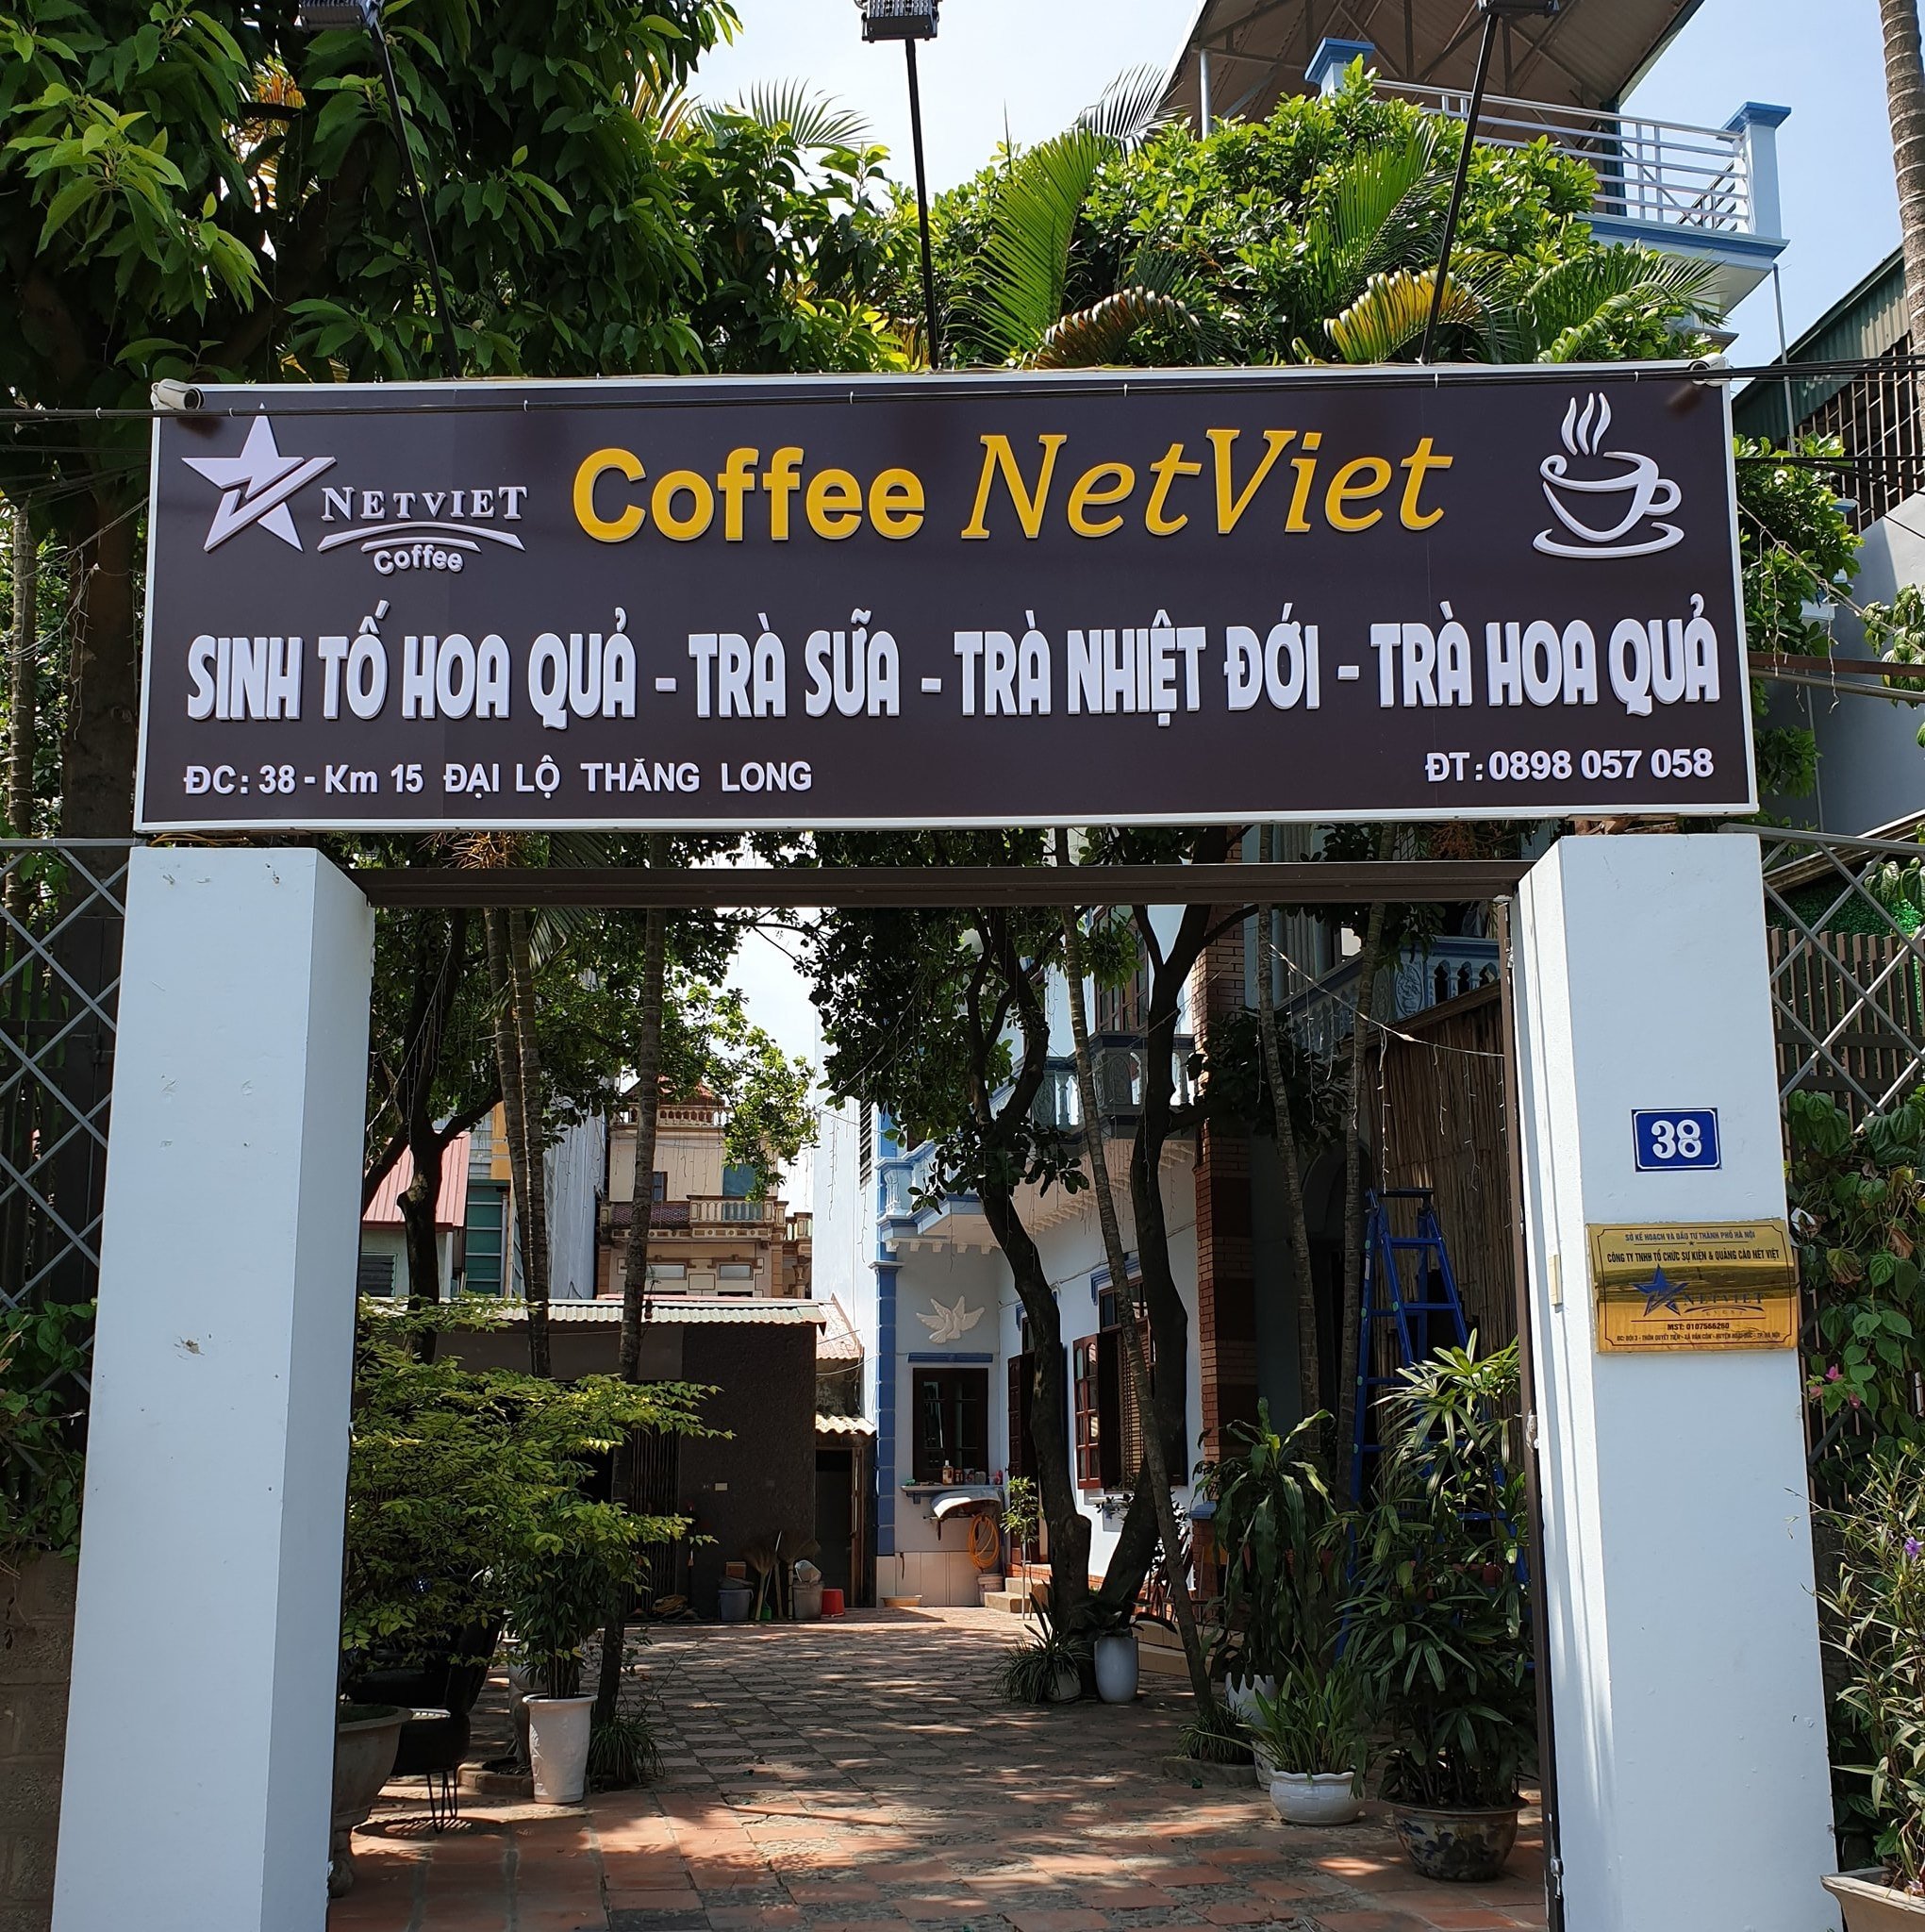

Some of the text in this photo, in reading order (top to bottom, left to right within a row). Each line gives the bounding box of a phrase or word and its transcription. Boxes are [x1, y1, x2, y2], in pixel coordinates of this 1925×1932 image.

[320, 485, 528, 523] NETVIET
[573, 428, 1453, 542] Coffee NetViet
[373, 544, 464, 575] Coffee
[188, 635, 303, 721] SINH
[318, 599, 390, 721] TỐ
[402, 633, 511, 720] HOA
[528, 606, 639, 730] QUẢ
[689, 612, 787, 719] TRÀ
[805, 608, 901, 719] SỮA
[954, 609, 1053, 717] TRÀ
[1067, 608, 1207, 727] NHIỆT
[1225, 603, 1320, 712] ĐỚI
[1370, 601, 1473, 709] TRÀ
[1486, 620, 1599, 708] HOA
[1609, 593, 1721, 717] QUẢ
[184, 765, 250, 796] ĐC:
[258, 765, 296, 794] 38
[325, 765, 378, 794] Km
[390, 763, 424, 794] 15
[442, 763, 501, 799] ĐẠI
[515, 755, 561, 801] LỘ
[581, 758, 701, 792] THĂNG
[721, 761, 812, 792] LONG
[1581, 749, 1642, 780] 057
[1651, 748, 1714, 778] 058
[1651, 1120, 1702, 1159] 38
[1607, 1251, 1625, 1263] CÔNG
[1626, 1252, 1634, 1262] TY
[1635, 1252, 1652, 1262] TNHH
[1692, 1249, 1707, 1262] KIỆN
